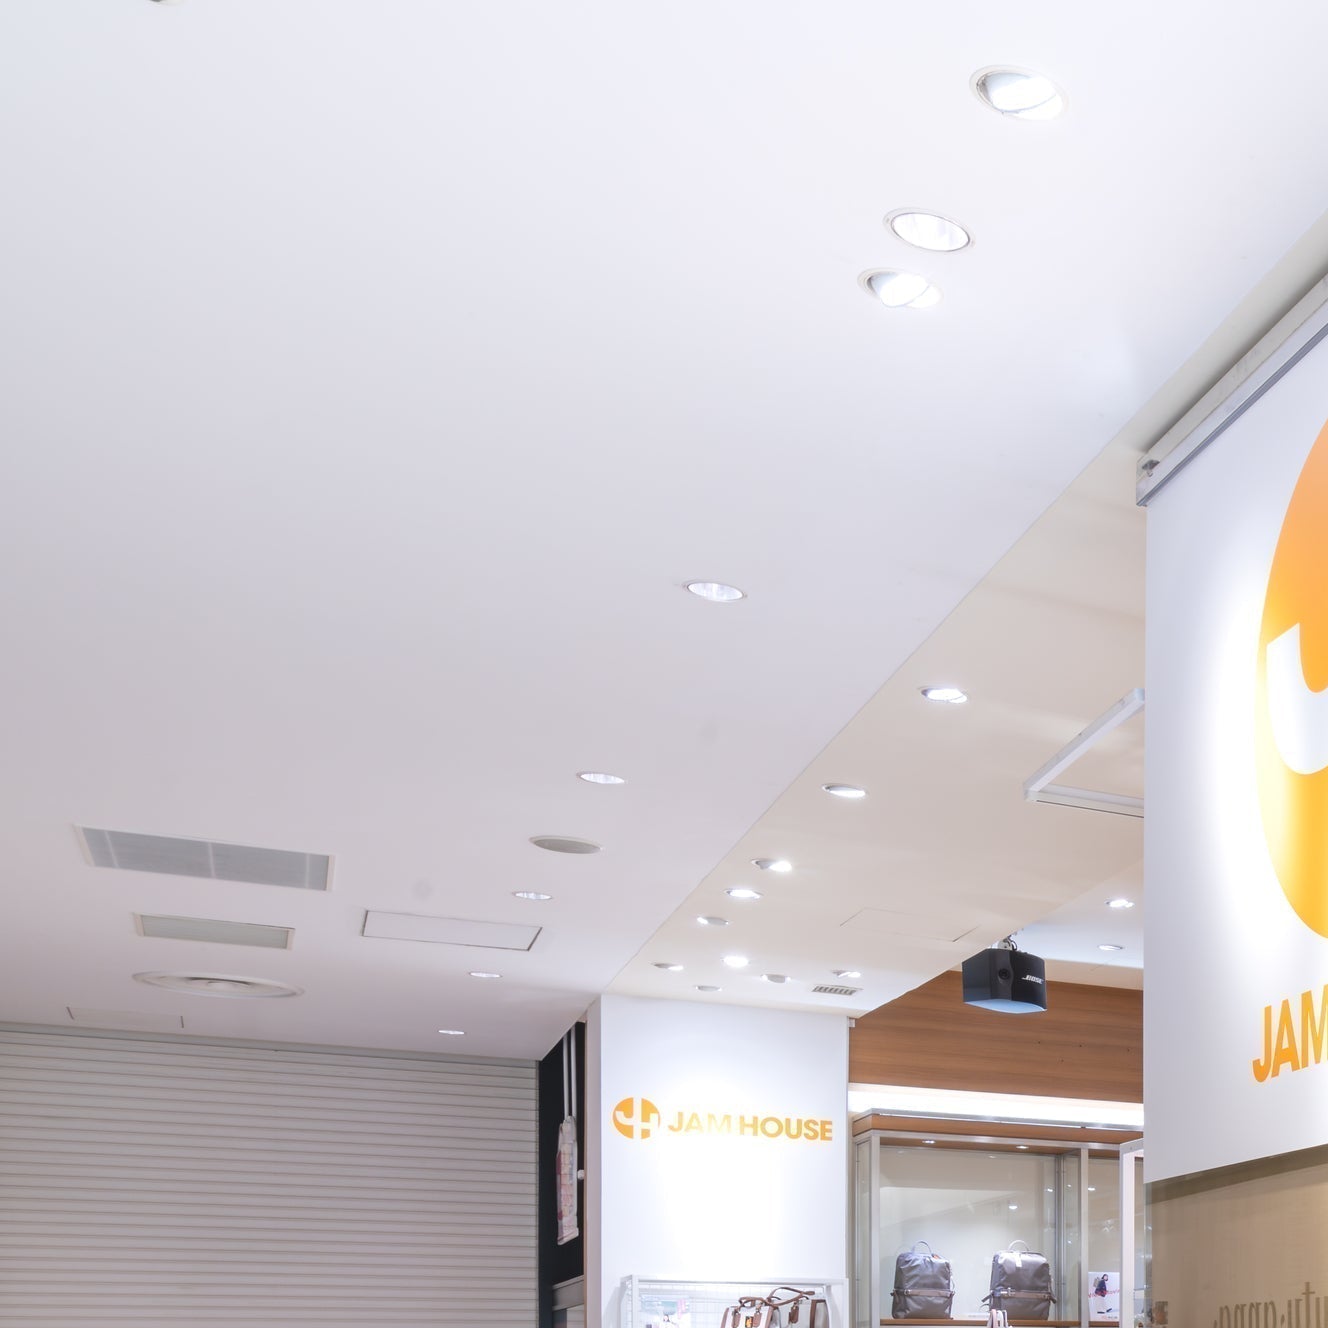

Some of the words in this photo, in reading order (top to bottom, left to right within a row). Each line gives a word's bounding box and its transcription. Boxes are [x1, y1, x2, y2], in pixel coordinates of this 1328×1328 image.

[1021, 975, 1044, 985] BOSE
[668, 1111, 732, 1133] JAM
[739, 1115, 833, 1141] HOUSE
